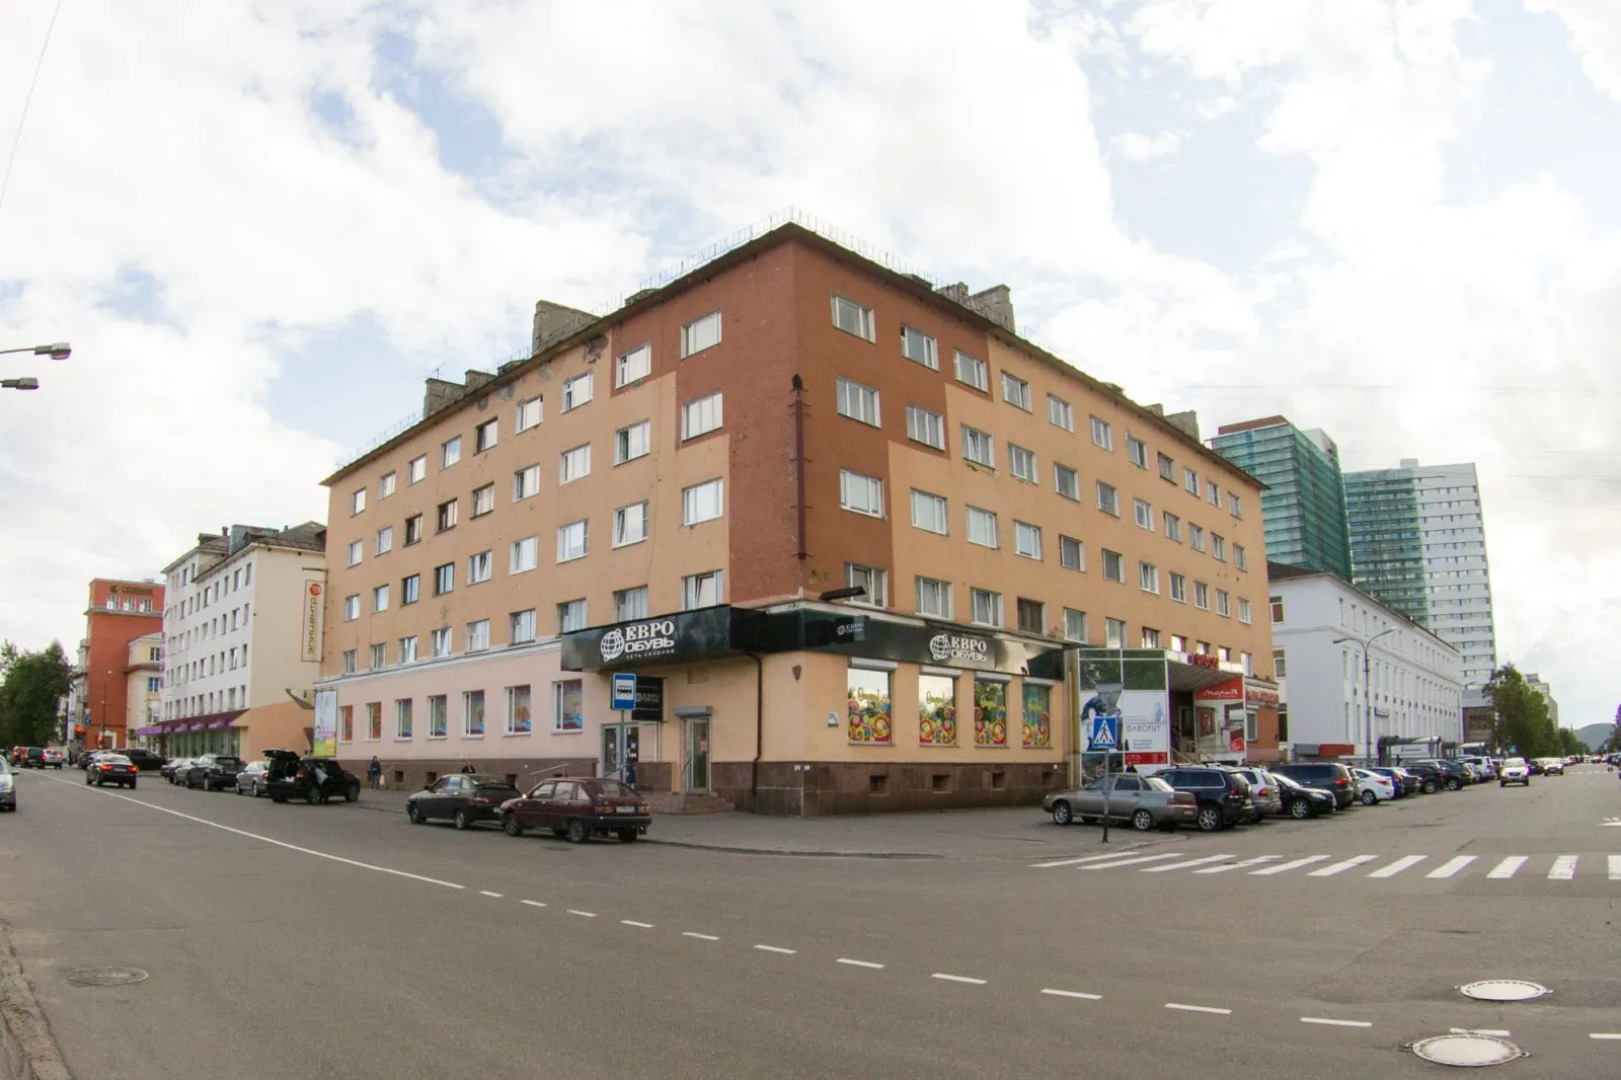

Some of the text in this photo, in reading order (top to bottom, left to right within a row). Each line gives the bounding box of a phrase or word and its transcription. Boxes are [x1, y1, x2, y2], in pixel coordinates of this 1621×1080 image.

[625, 621, 675, 641] ЕВРО
[624, 637, 675, 653] ОБУВЬ
[950, 636, 987, 653] ЕВРО
[950, 649, 987, 662] ОБУВЬ
